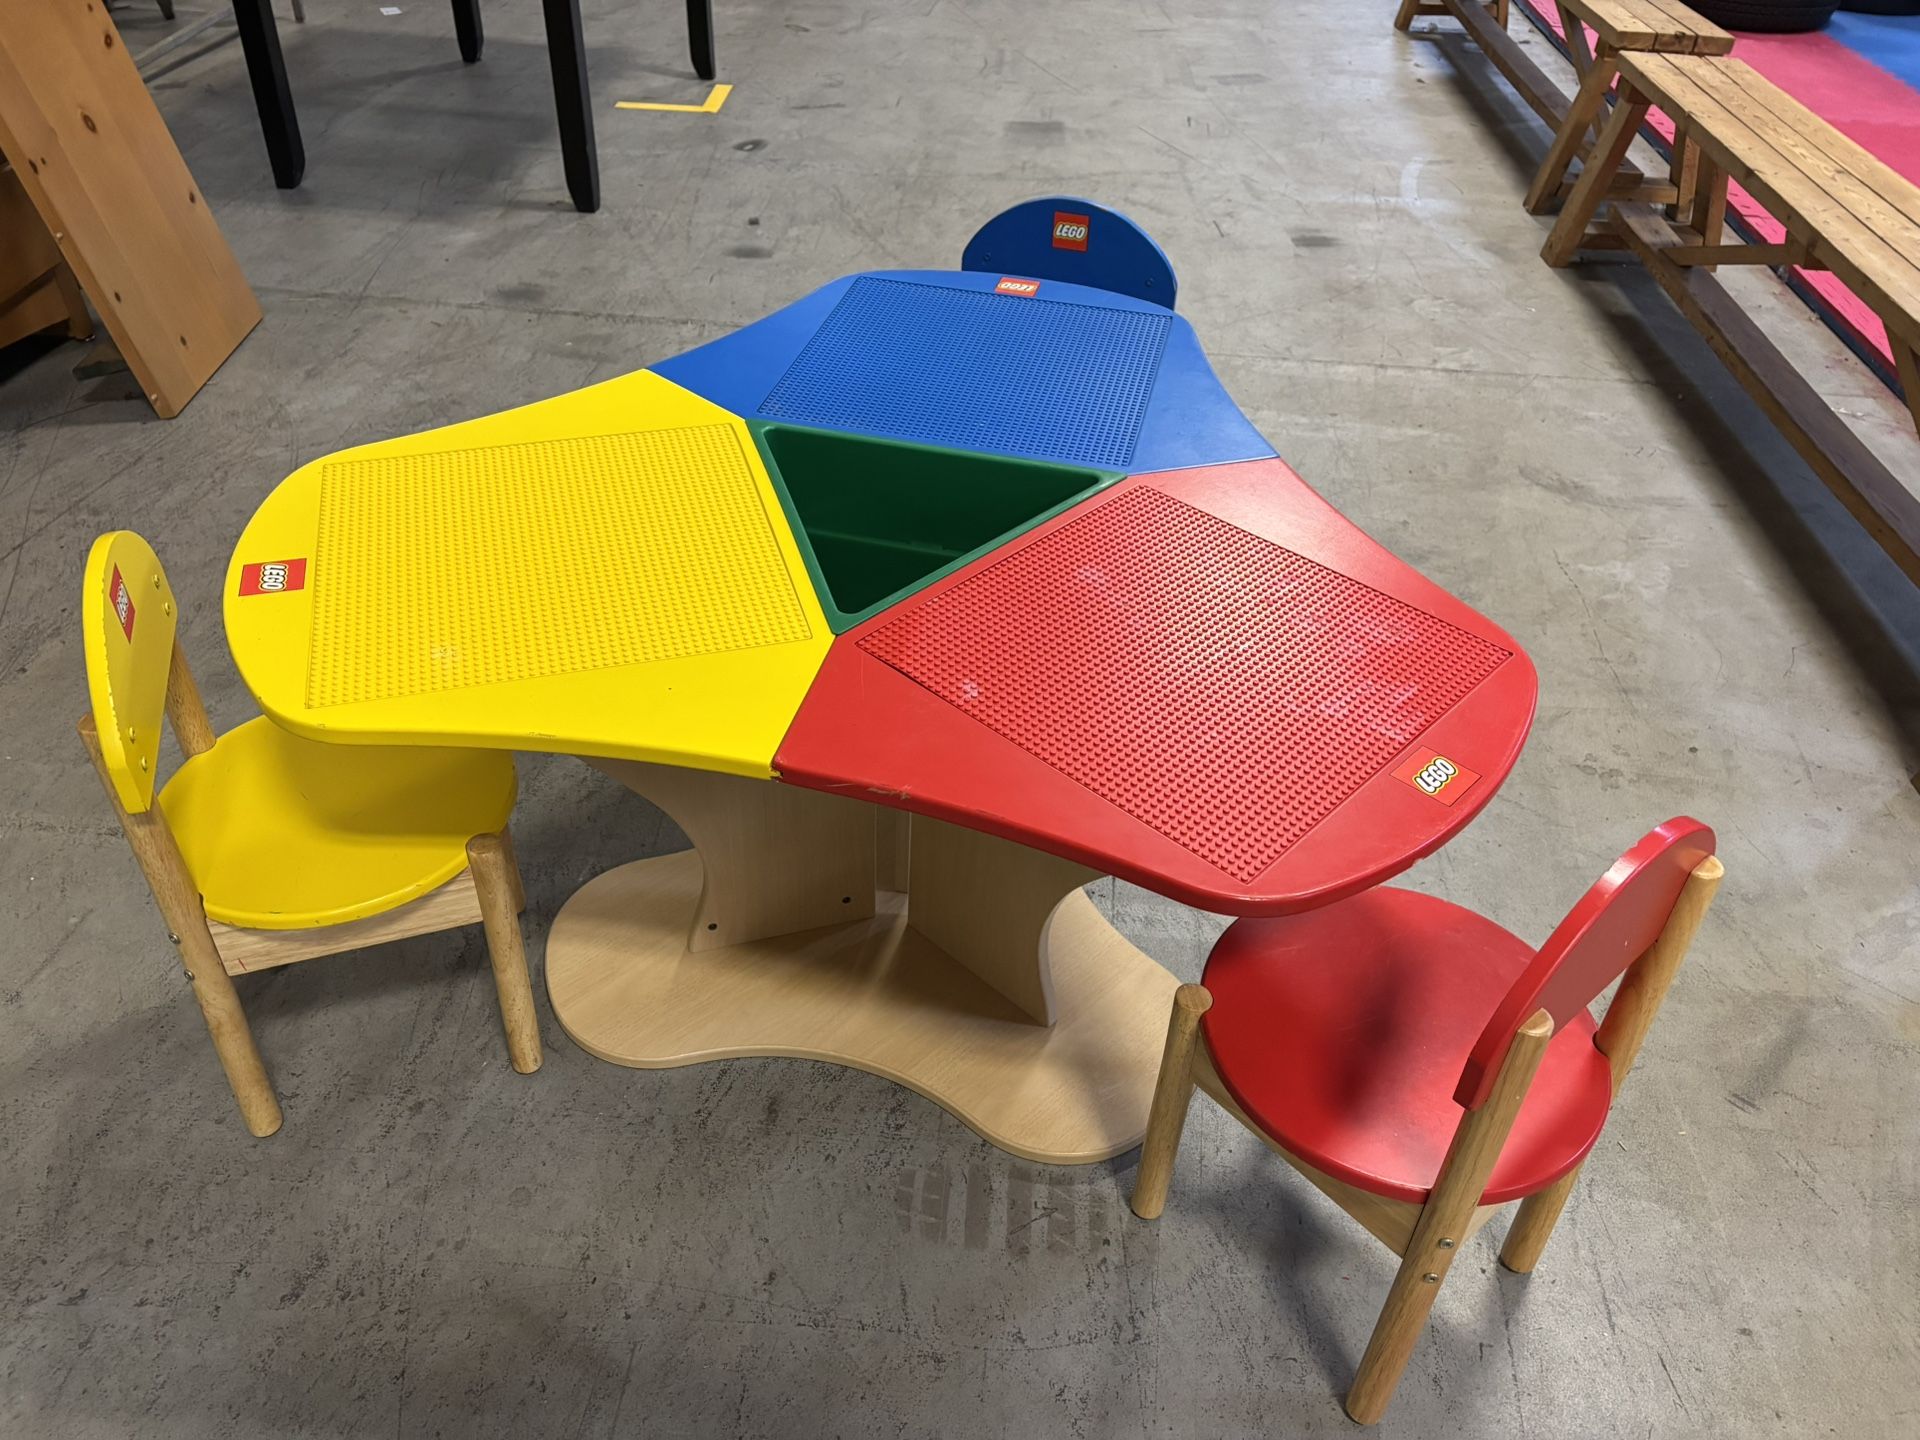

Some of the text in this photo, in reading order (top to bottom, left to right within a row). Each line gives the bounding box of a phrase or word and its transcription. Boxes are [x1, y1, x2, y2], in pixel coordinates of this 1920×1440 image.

[1055, 223, 1087, 239] LEGO
[261, 564, 286, 590] LEGO
[1415, 757, 1457, 793] LEGO
